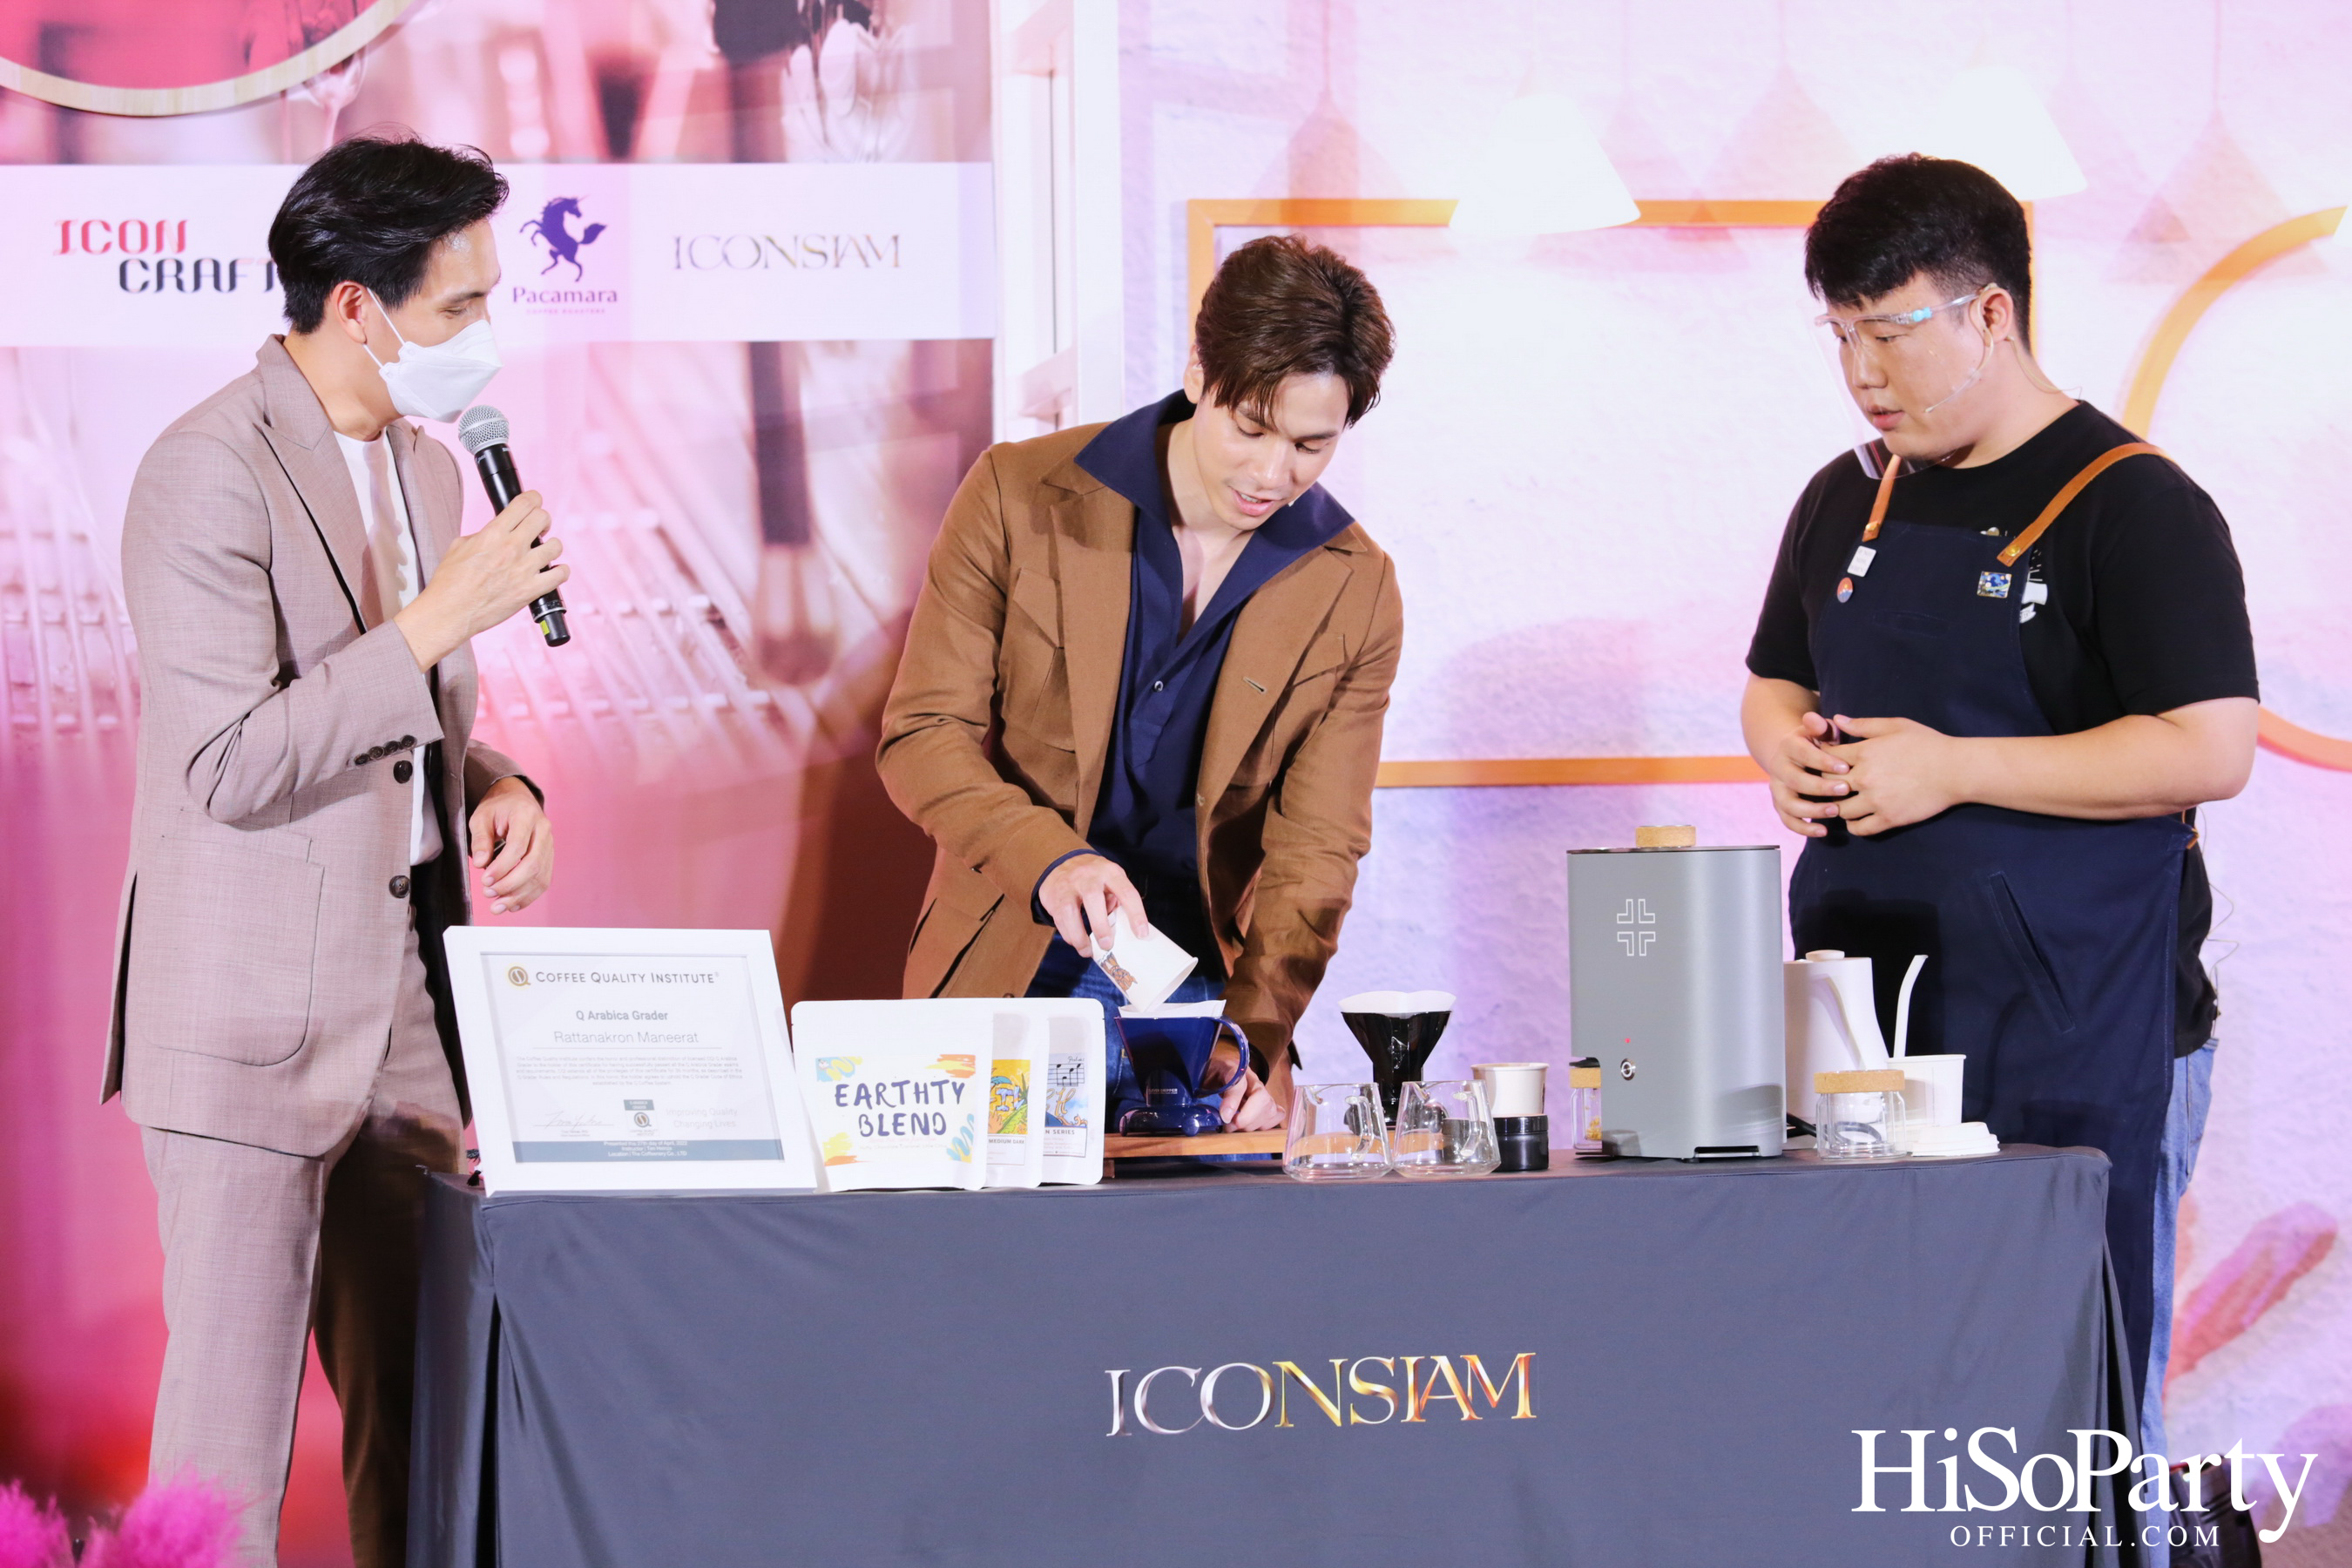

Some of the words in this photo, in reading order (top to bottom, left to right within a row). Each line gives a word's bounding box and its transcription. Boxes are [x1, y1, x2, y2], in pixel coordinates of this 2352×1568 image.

[53, 219, 188, 255] ICON
[672, 233, 901, 270] ICONSIAM
[118, 258, 274, 294] CRAFT
[513, 287, 618, 303] Pacamara
[535, 971, 586, 983] COFFEE
[591, 971, 645, 984] QUALITY
[576, 1010, 585, 1020] Q
[587, 1010, 629, 1020] Arabica
[632, 1010, 668, 1020] Grader
[553, 1031, 634, 1043] Rattanakron
[638, 1032, 699, 1043] Maneerat
[835, 1079, 965, 1110] EARTHTY
[666, 1108, 707, 1118] Improving
[709, 1107, 738, 1117] Quality
[673, 1119, 713, 1130] Changing
[858, 1112, 947, 1137] BLEND
[1104, 1352, 1537, 1436] ICONSIAM
